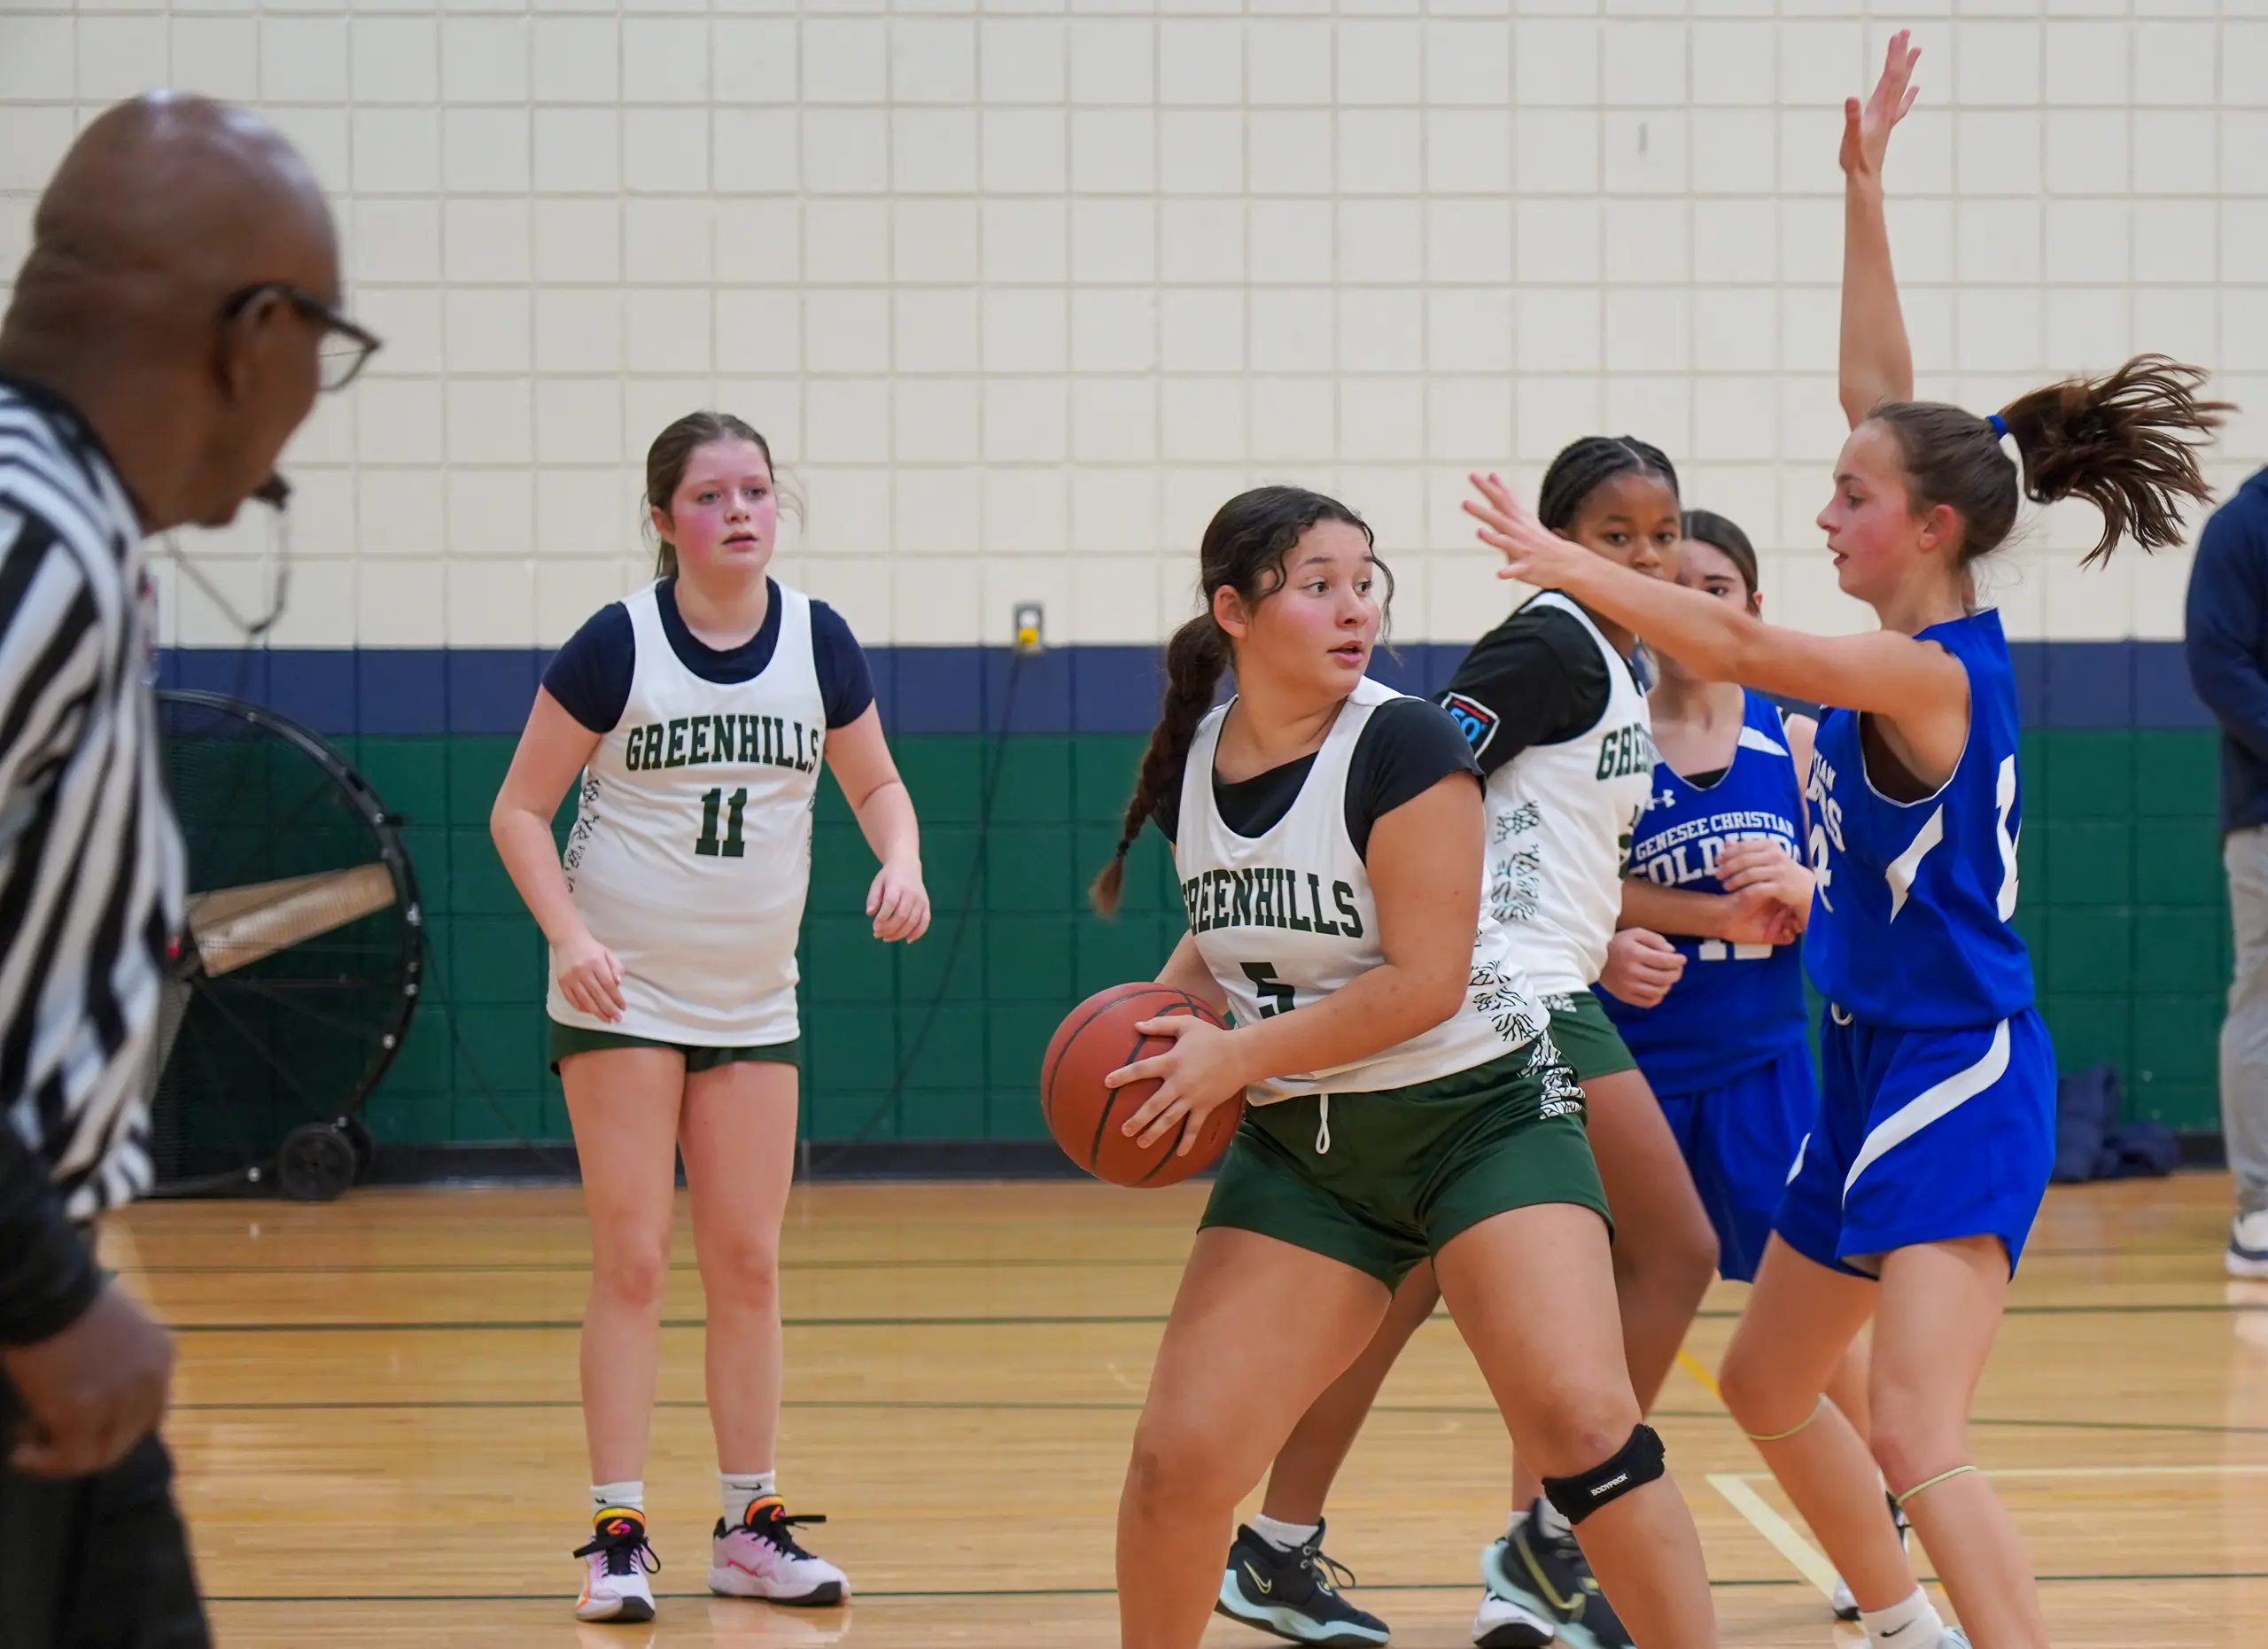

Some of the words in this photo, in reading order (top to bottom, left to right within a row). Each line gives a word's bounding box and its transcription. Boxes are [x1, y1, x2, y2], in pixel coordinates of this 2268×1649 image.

[625, 713, 819, 775] GREENHILLS
[695, 788, 748, 858] 11
[1635, 817, 1710, 861] GENESEE
[1710, 811, 1795, 839] CHRISTIAN
[1182, 867, 1363, 939] REENHILLS
[1239, 961, 1296, 1020] 5
[1590, 1473, 1628, 1497] BODYPROX
